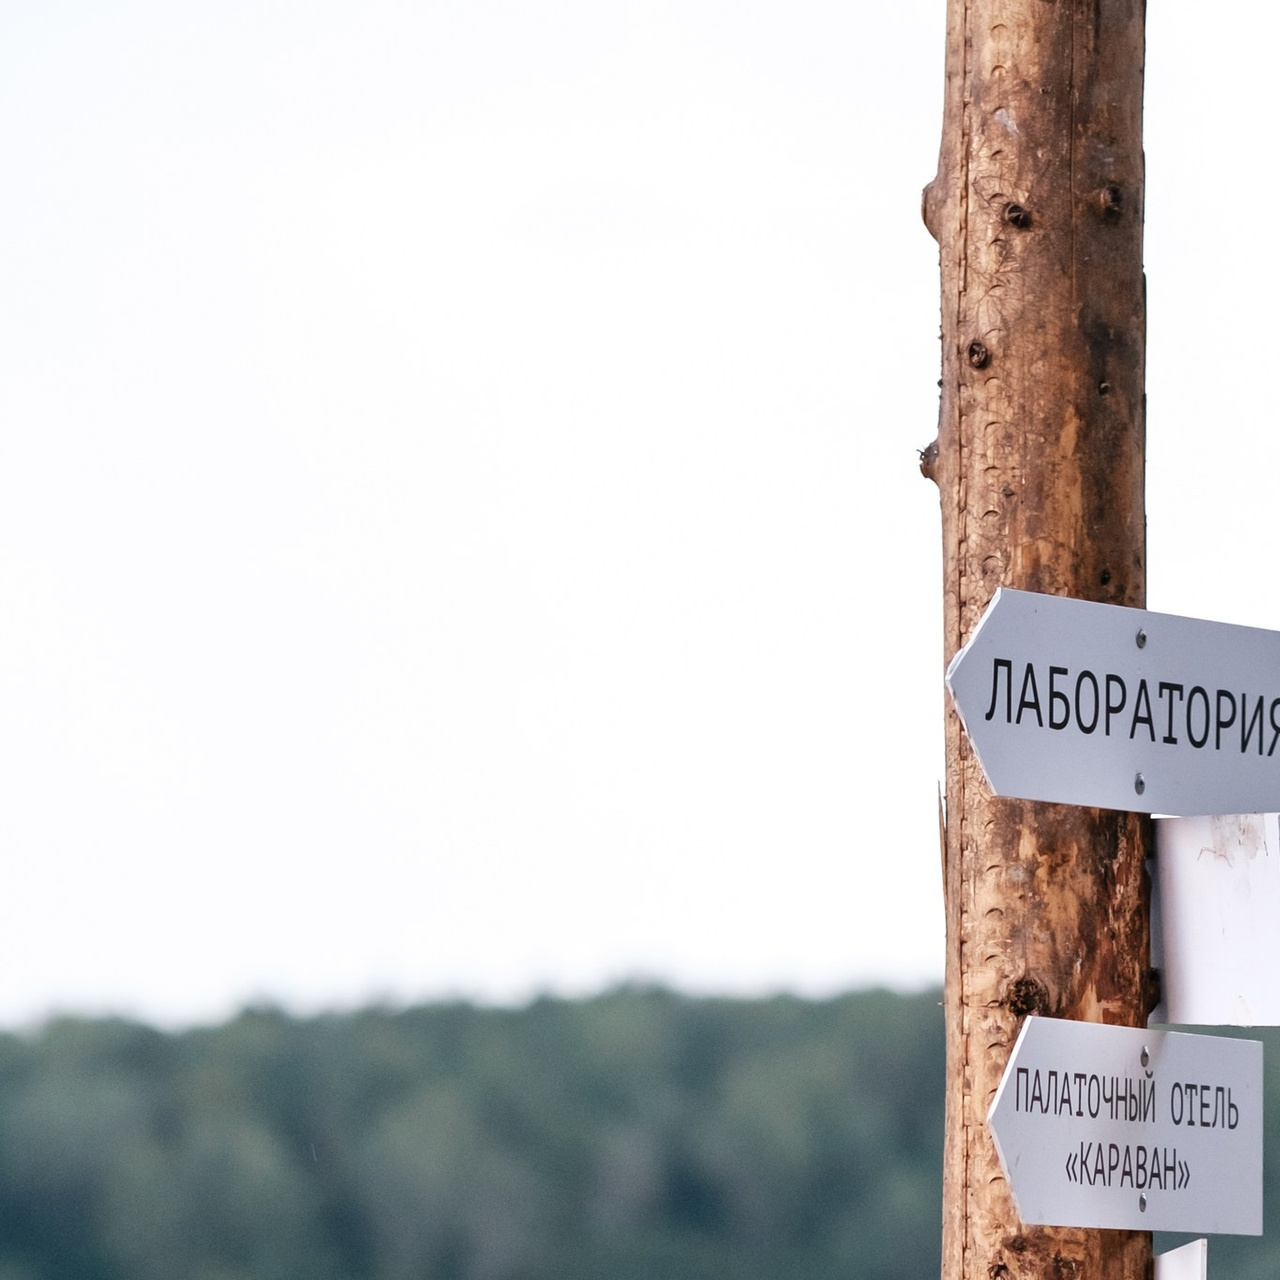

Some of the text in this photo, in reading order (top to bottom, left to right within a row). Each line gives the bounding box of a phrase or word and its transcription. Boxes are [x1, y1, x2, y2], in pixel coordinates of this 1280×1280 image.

[1015, 1067, 1239, 1130] ПАЛАТОЧНЫЙ ОТЕЛЬ
[1065, 1141, 1191, 1191] «КАРАВАН»
